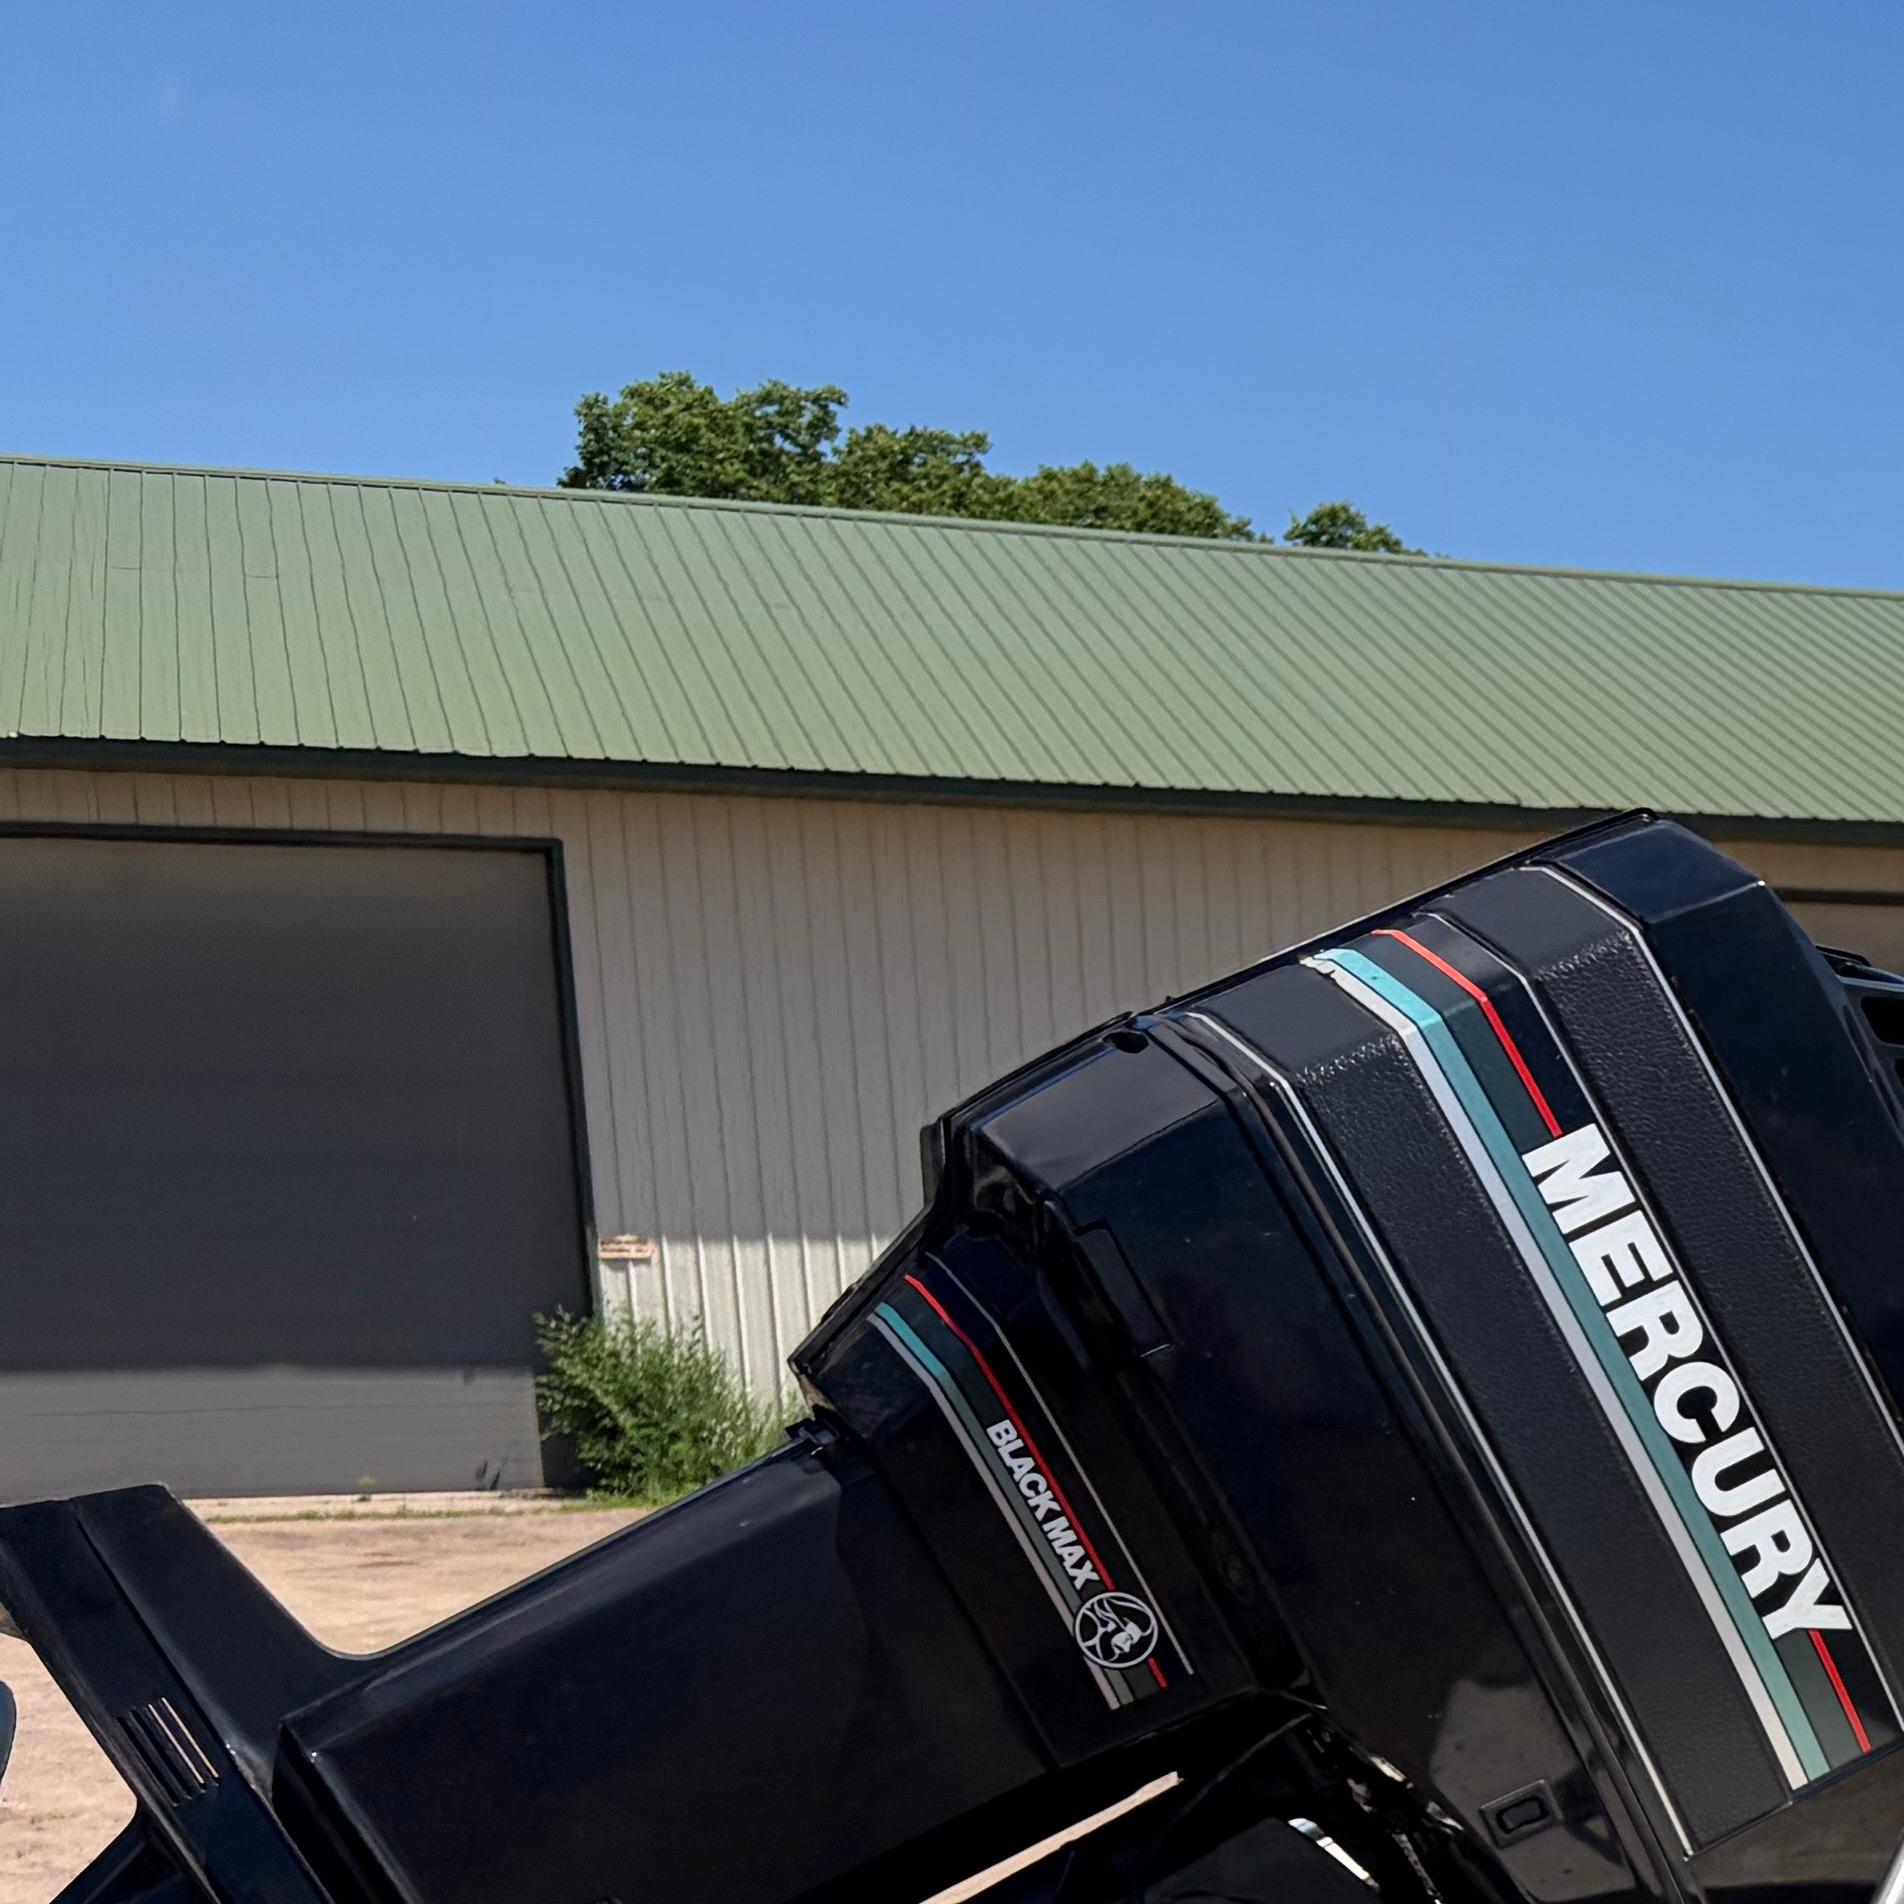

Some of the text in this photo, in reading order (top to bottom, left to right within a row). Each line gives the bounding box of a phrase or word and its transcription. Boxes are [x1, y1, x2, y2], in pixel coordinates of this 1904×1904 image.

[986, 1418, 1101, 1591] BLACK MAX
[1521, 1122, 1854, 1640] MERCURY
